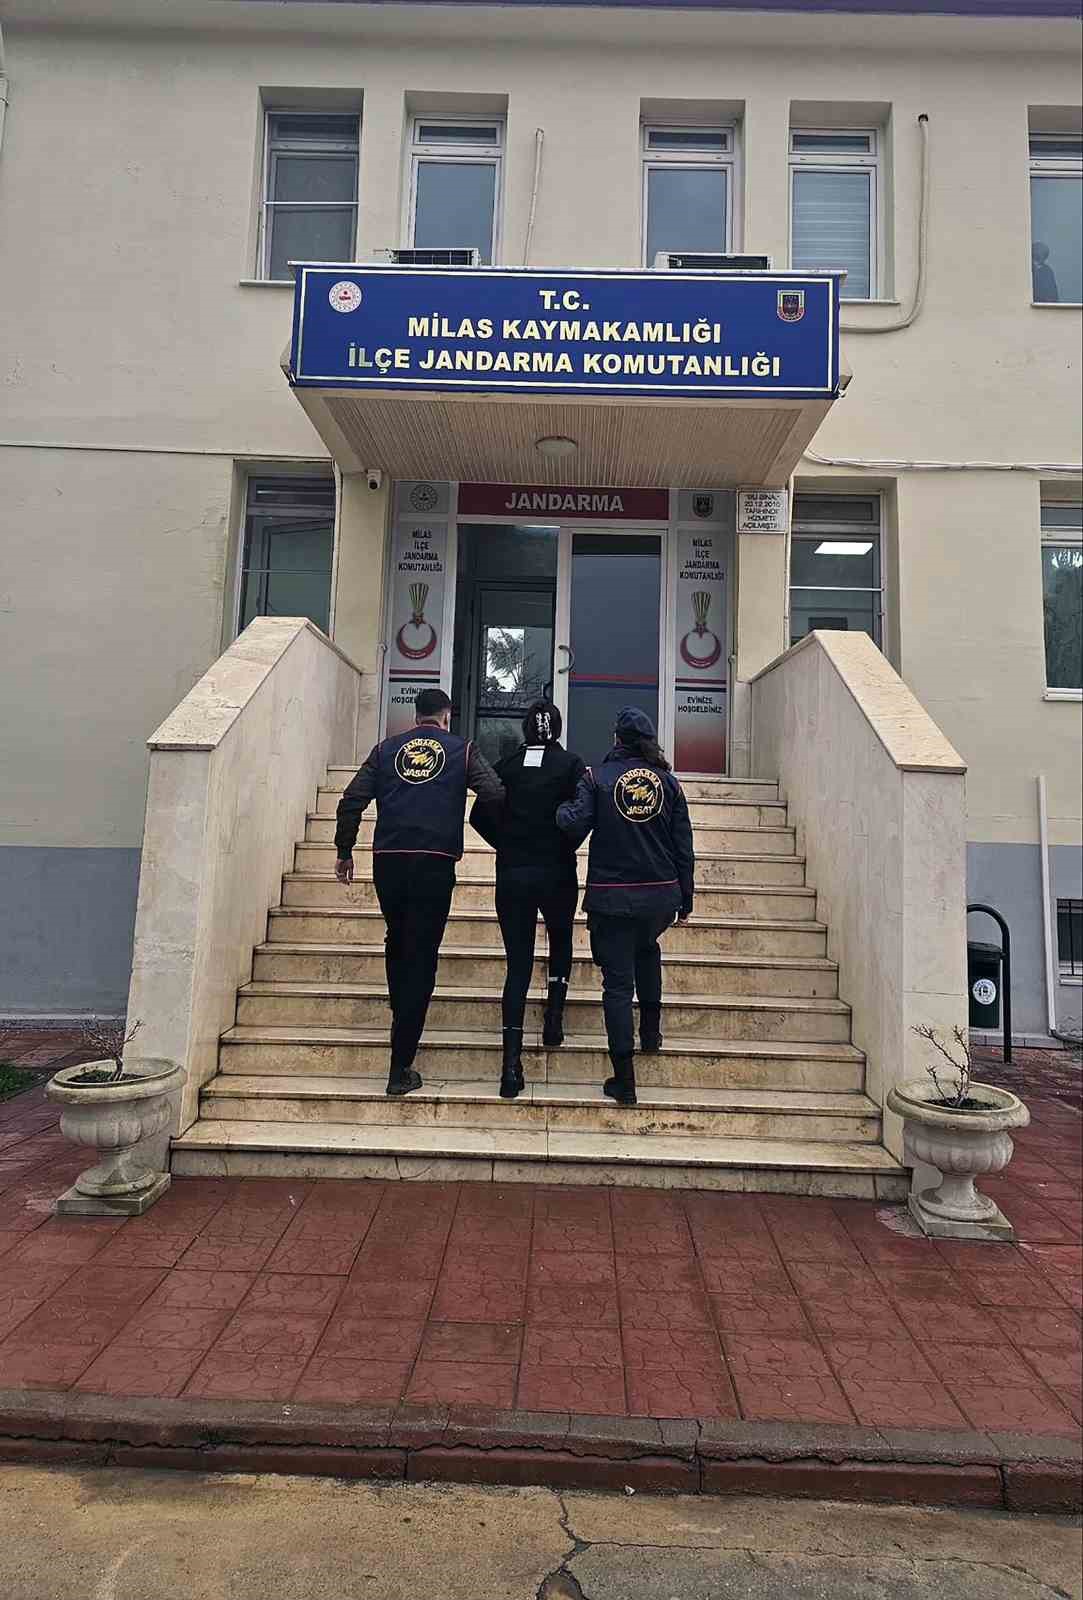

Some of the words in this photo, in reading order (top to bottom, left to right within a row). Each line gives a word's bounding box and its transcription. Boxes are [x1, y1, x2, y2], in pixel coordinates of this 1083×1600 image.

[539, 289, 590, 310] T.C.
[408, 312, 493, 338] MİLAS
[502, 318, 721, 343] KAYMAKAMLIĞI
[348, 342, 411, 374] İLÇE
[419, 349, 573, 373] JANDARMA
[583, 352, 780, 377] KOMUTANLIĞI
[505, 492, 624, 512] JANDARMA
[414, 540, 430, 550] İLÇE
[403, 552, 439, 560] JANDARMA
[695, 549, 710, 560] İLÇE
[398, 561, 442, 572] KOMUTANLIĞI
[685, 561, 719, 569] JANDARMA
[679, 570, 725, 580] KOMUTANLIĞI
[687, 695, 713, 704] EVİNİZE
[677, 703, 722, 714] HOŞGELDİNİZ
[403, 738, 443, 753] JANDARMA
[403, 769, 431, 777] JASAT
[619, 768, 661, 787] JANDARMA
[626, 805, 654, 815] JASAT
